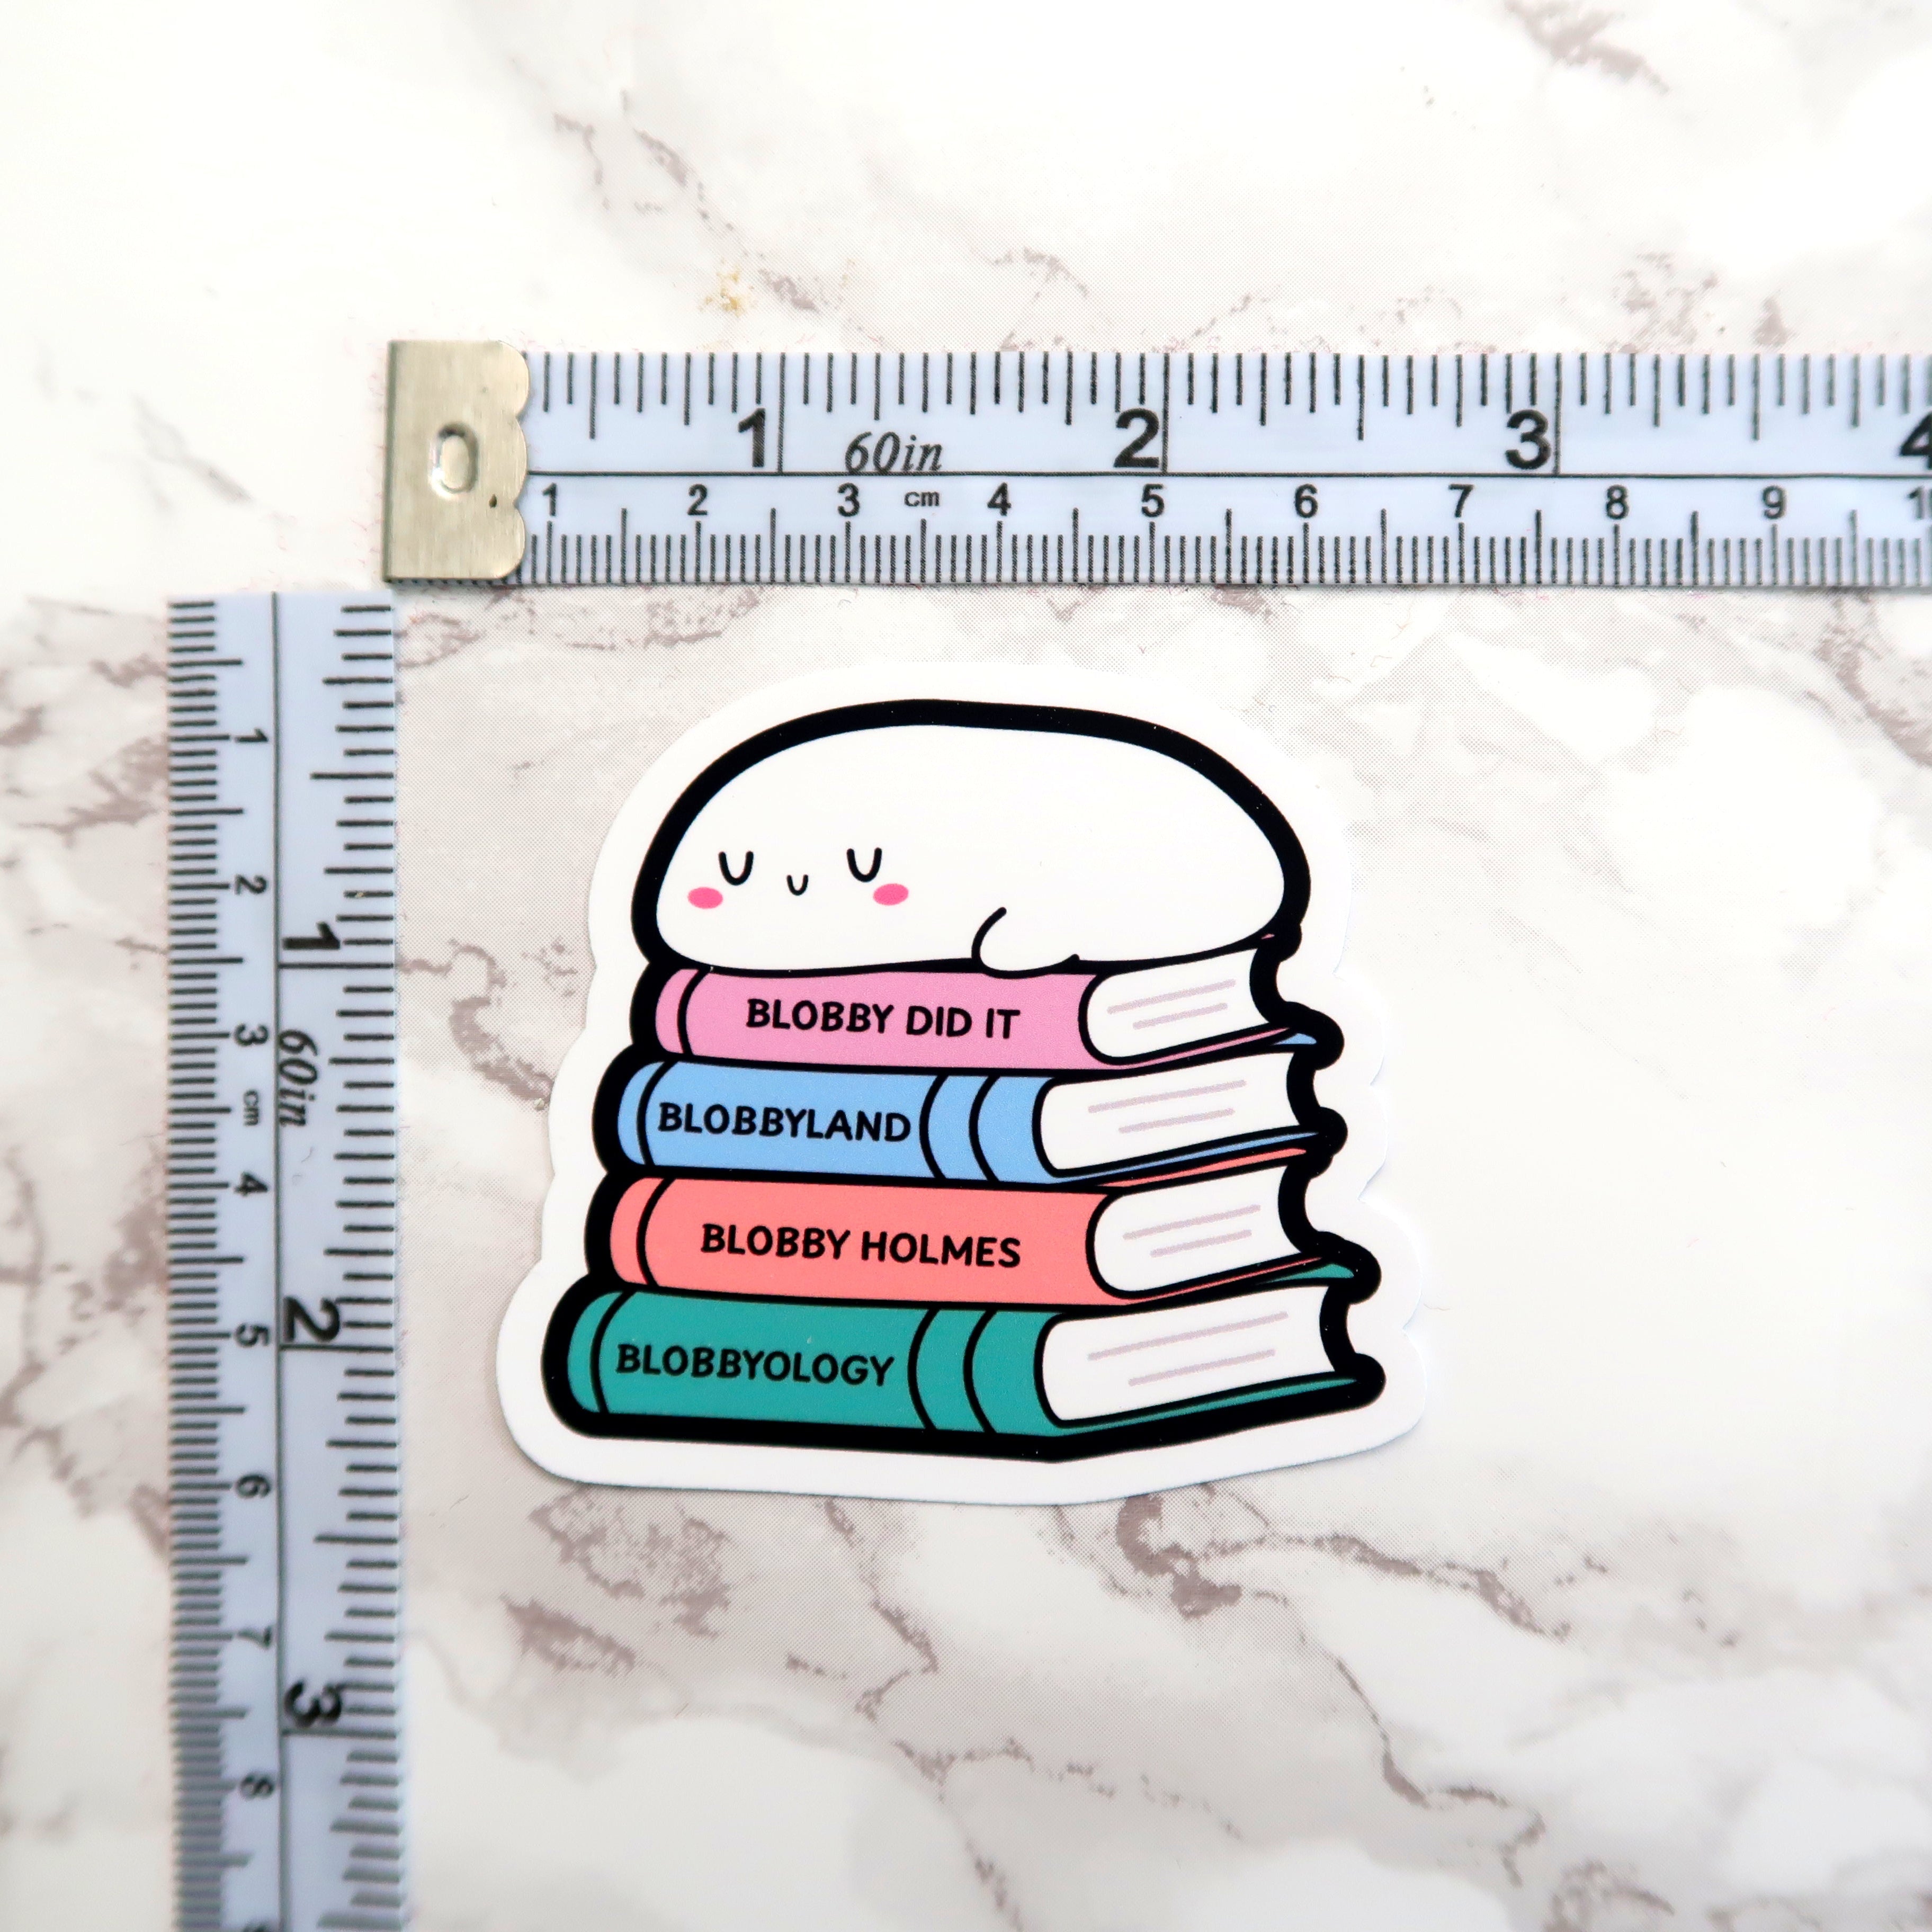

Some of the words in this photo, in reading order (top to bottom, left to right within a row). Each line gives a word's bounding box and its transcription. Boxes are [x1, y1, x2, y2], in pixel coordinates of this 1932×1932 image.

[738, 408, 766, 468] 1
[845, 432, 943, 472] 60in
[1113, 408, 1160, 468] 2
[1505, 409, 1551, 469] 3
[1900, 411, 1932, 470] 4
[543, 483, 558, 516] 1
[687, 484, 708, 516] 2
[838, 483, 860, 517] 3
[904, 491, 940, 507] cm
[987, 482, 1011, 516] 4
[1142, 484, 1164, 517] 5
[1294, 484, 1318, 518] 6
[1448, 484, 1473, 518] 7
[1605, 485, 1629, 520] 8
[1761, 486, 1785, 520] 9
[1907, 486, 1932, 520] 1
[235, 728, 268, 743] 1
[235, 875, 266, 895] 2
[282, 922, 341, 950] 1
[234, 1024, 269, 1046] 3
[746, 998, 894, 1034] BLOBBY
[906, 1006, 972, 1037] DID
[986, 1008, 1021, 1039] IT
[278, 1028, 318, 1127] 60in
[244, 1089, 261, 1126] cm
[658, 1102, 911, 1142] BLOBBYLAND
[235, 1173, 269, 1196] 4
[701, 1223, 851, 1259] BLOBBY
[862, 1231, 1020, 1268] HOLMES
[234, 1323, 270, 1347] 5
[282, 1296, 341, 1344] 2
[616, 1344, 895, 1387] BLOBBYOLOGY
[235, 1473, 272, 1498] 6
[237, 1624, 273, 1649] 7
[284, 1680, 343, 1728] 3
[239, 1773, 274, 1799] 8
